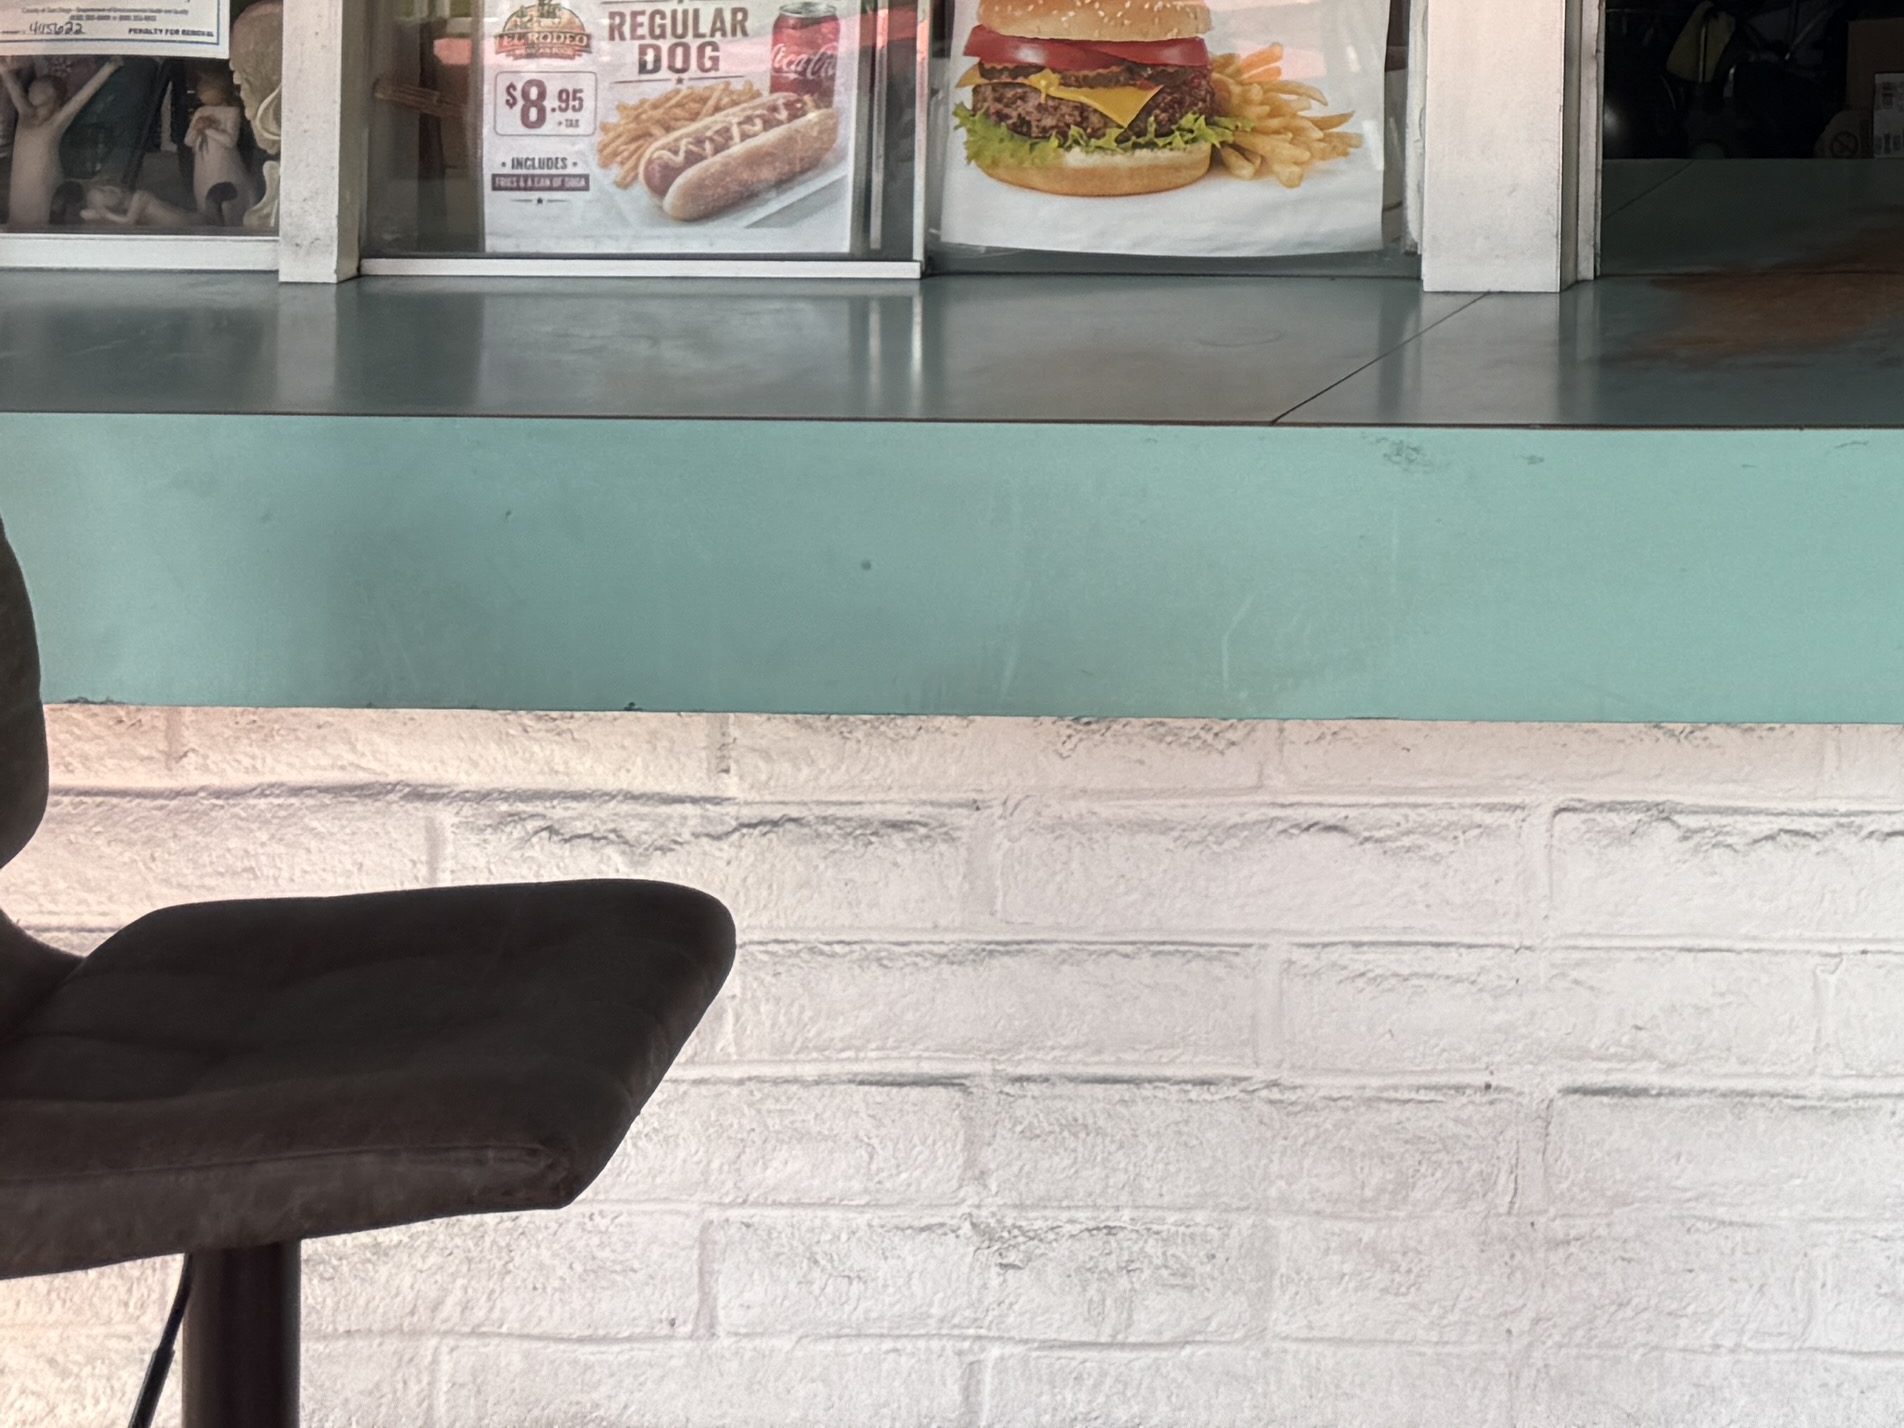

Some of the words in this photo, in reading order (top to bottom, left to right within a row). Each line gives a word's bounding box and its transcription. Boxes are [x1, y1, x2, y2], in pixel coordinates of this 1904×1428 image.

[608, 7, 749, 41] REGULAR
[638, 41, 720, 75] DOG
[512, 157, 568, 170] INCLUDES
